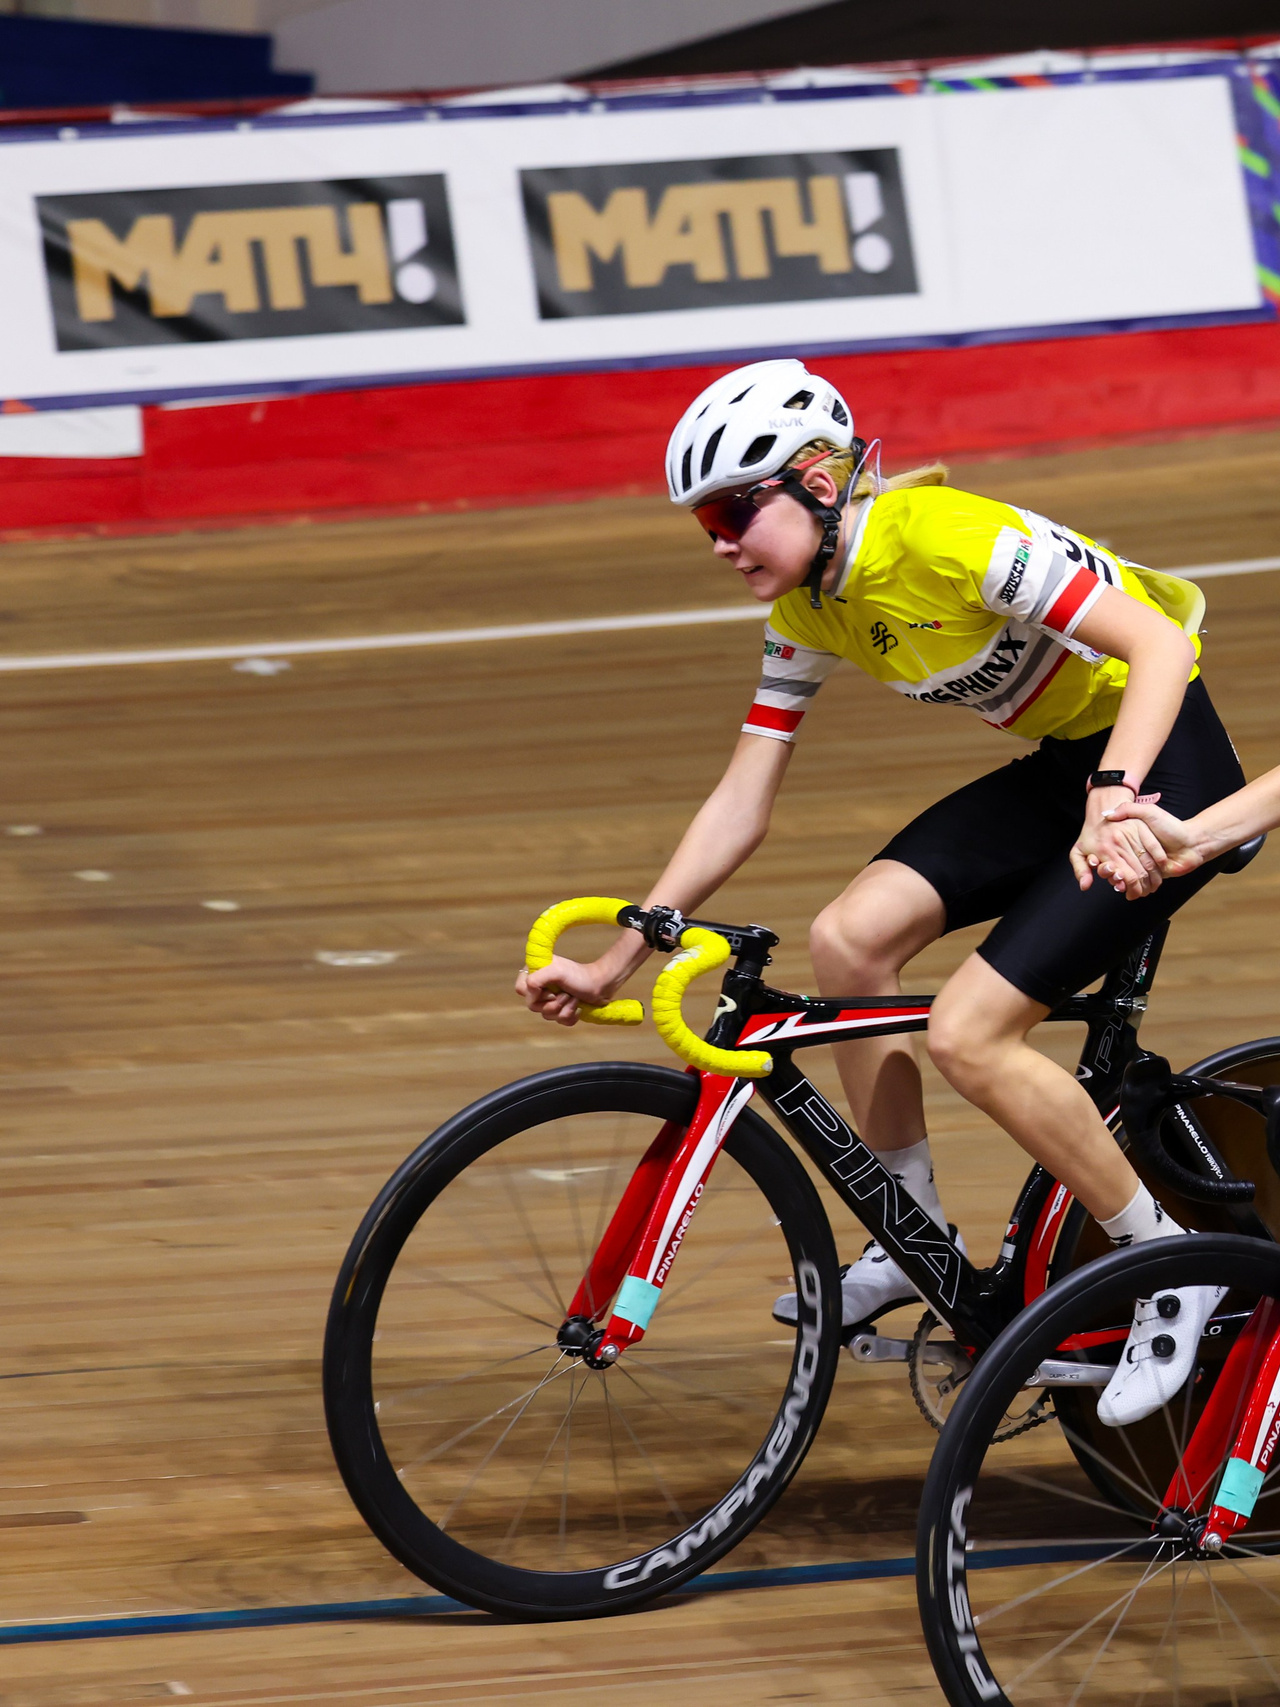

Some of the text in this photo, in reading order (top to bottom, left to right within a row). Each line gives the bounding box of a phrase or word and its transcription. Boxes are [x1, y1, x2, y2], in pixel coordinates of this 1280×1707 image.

[656, 1181, 704, 1283] PINARELLO
[775, 1078, 962, 1309] PINA
[1175, 1104, 1208, 1154] PINARELLO
[603, 1260, 823, 1590] CAMPAGNOLO
[947, 1486, 1001, 1702] PISTA
